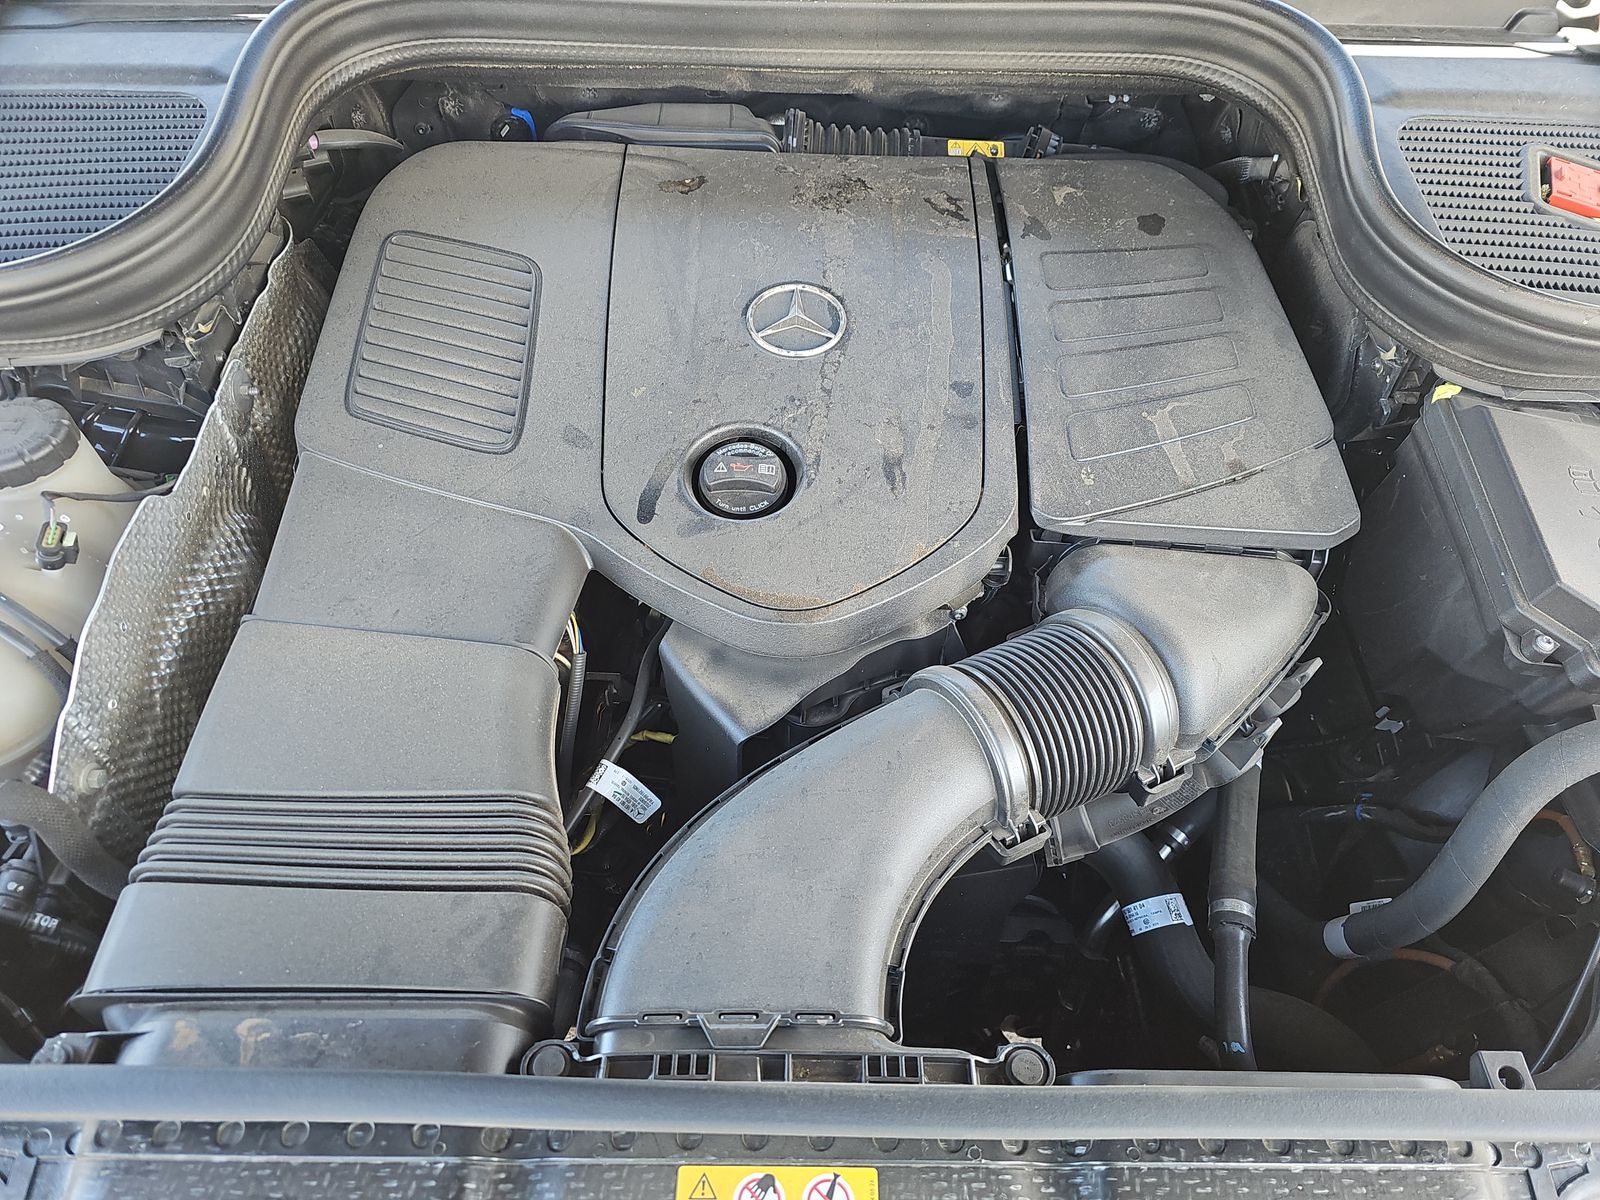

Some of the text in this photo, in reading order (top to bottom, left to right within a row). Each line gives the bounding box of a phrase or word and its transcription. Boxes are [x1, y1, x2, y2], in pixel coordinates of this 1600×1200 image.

[717, 443, 766, 455] Mercedes-Benz
[716, 499, 729, 509] Turn
[749, 500, 769, 511] CLICK
[34, 913, 59, 928] TOP
